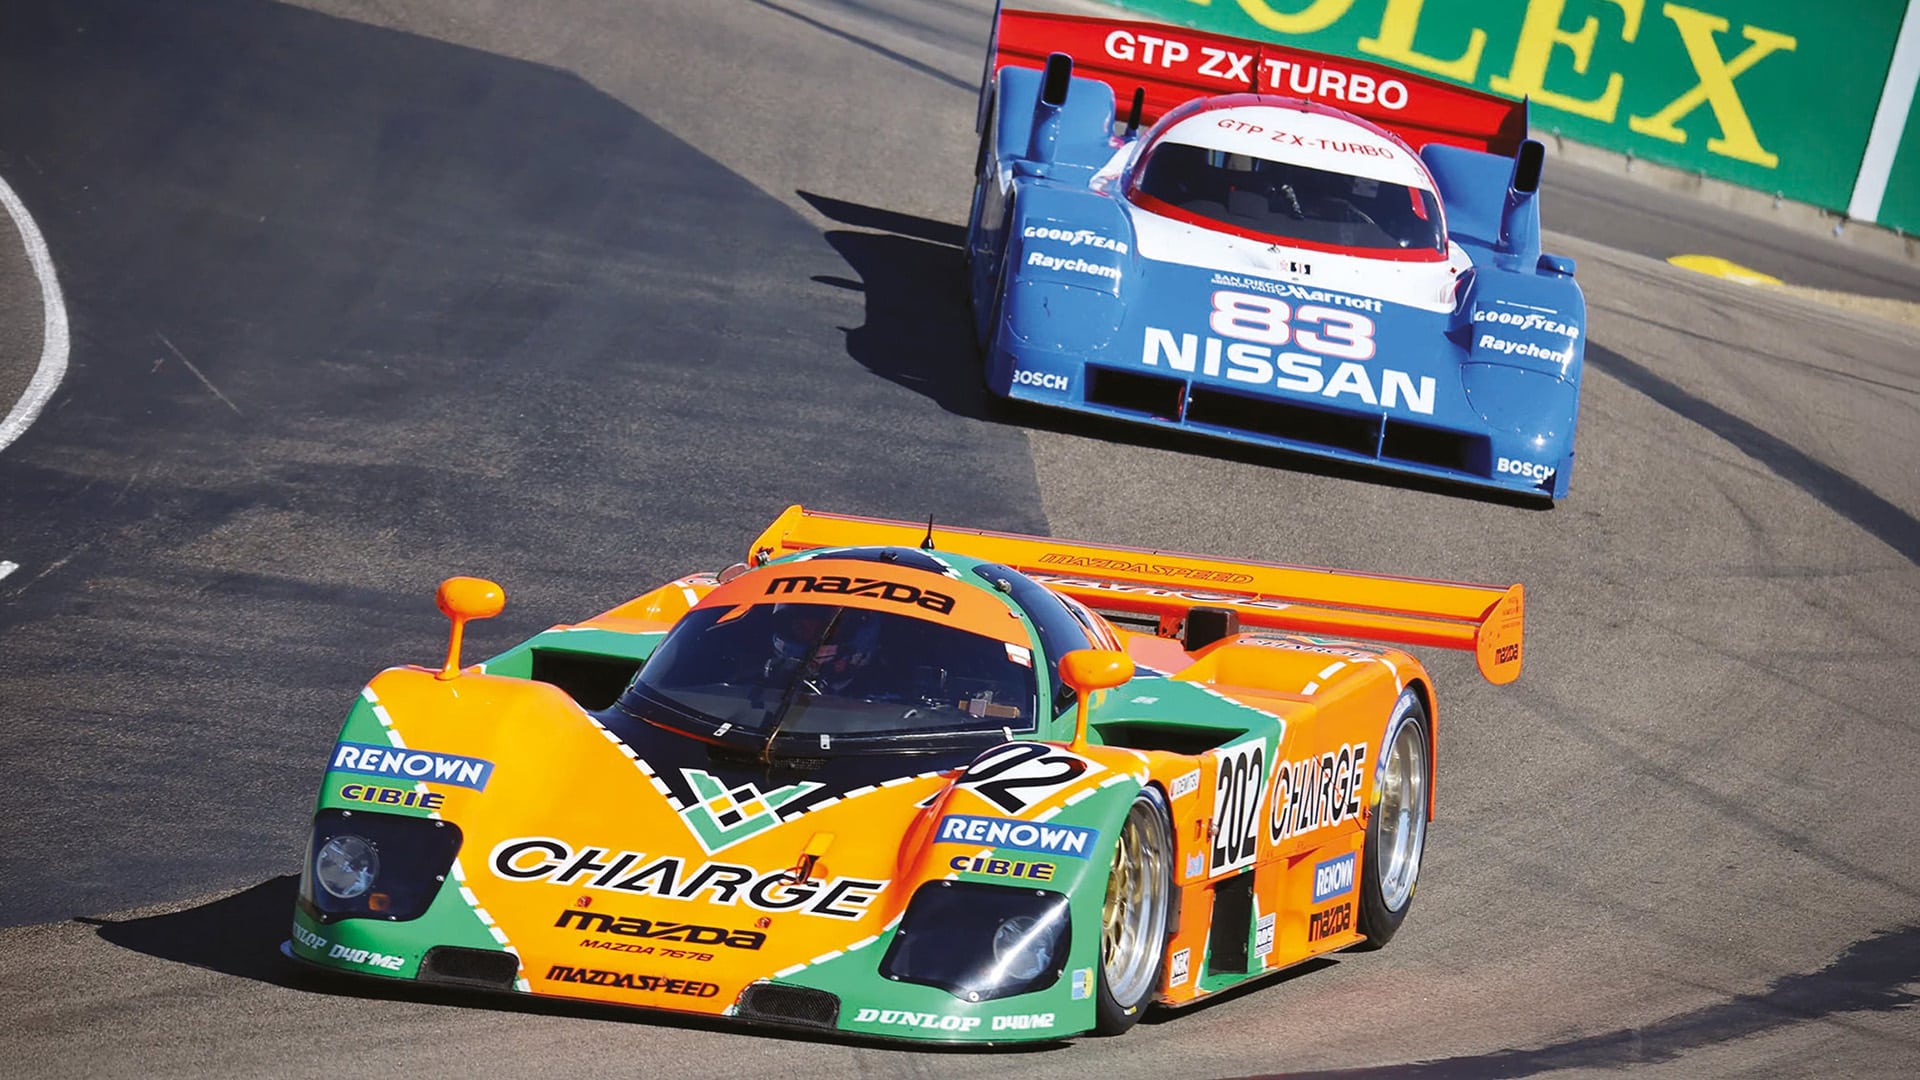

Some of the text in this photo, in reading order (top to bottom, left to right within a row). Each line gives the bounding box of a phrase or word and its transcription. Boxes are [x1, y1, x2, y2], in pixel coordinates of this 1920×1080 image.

[1104, 30, 1190, 69] GTP
[1197, 46, 1254, 84] ZX
[1218, 118, 1264, 134] GTP
[1024, 226, 1129, 256] GOODYEAR
[1027, 252, 1122, 280] Raychem
[1275, 284, 1383, 313] Marriott
[1209, 290, 1376, 361] 83
[1474, 310, 1580, 340] GOODYEAR
[1479, 334, 1570, 366] Raychem
[1142, 327, 1436, 415] NISSAN
[1038, 553, 1255, 585] MAZDASPEED
[334, 745, 488, 785] RENOWN
[921, 743, 1088, 814] 02
[1212, 746, 1263, 870] 202
[1269, 741, 1367, 846] CHARGE
[942, 818, 1088, 853] RENOWN
[488, 836, 892, 922] CHARGE
[1316, 858, 1354, 897] RENOWN
[579, 939, 714, 962] MAZDA 767B
[545, 965, 720, 998] MAZDASPEED
[854, 1008, 981, 1031] DUNLOP
